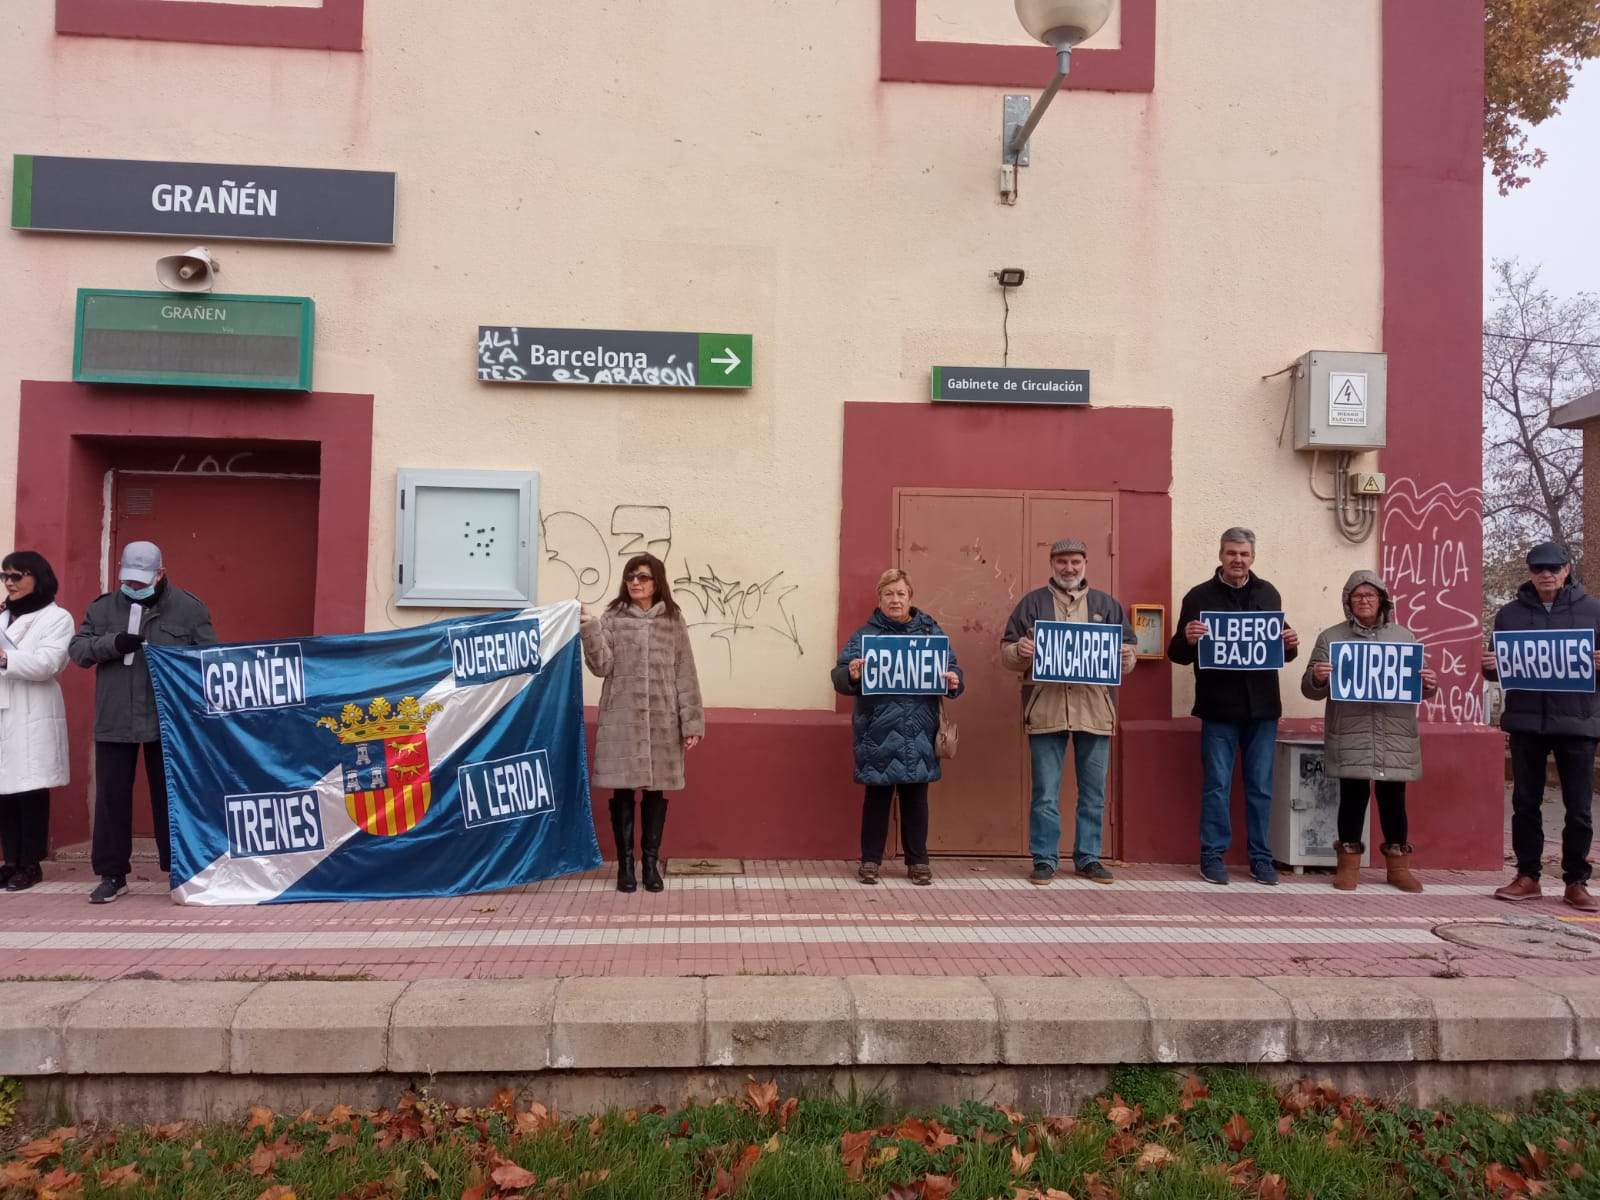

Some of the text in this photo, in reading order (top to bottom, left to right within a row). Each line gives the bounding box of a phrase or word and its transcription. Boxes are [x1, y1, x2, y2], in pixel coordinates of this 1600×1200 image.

[151, 180, 278, 217] GRAÑÉN
[530, 345, 648, 369] Barcelona
[947, 378, 1083, 392] Gabinete de Circulación
[452, 628, 540, 678] QUEREMOS
[1033, 628, 1120, 680] SANGARREN
[1199, 617, 1281, 641] ALBERO
[1213, 641, 1267, 666] BAJO
[205, 647, 301, 709] GRAÑÉN
[863, 638, 947, 689] GRAÑÉN
[1338, 643, 1413, 700] CURBE
[1496, 638, 1593, 680] BARBUES
[465, 767, 550, 820] A LERIDA
[228, 794, 319, 854] TRENES
